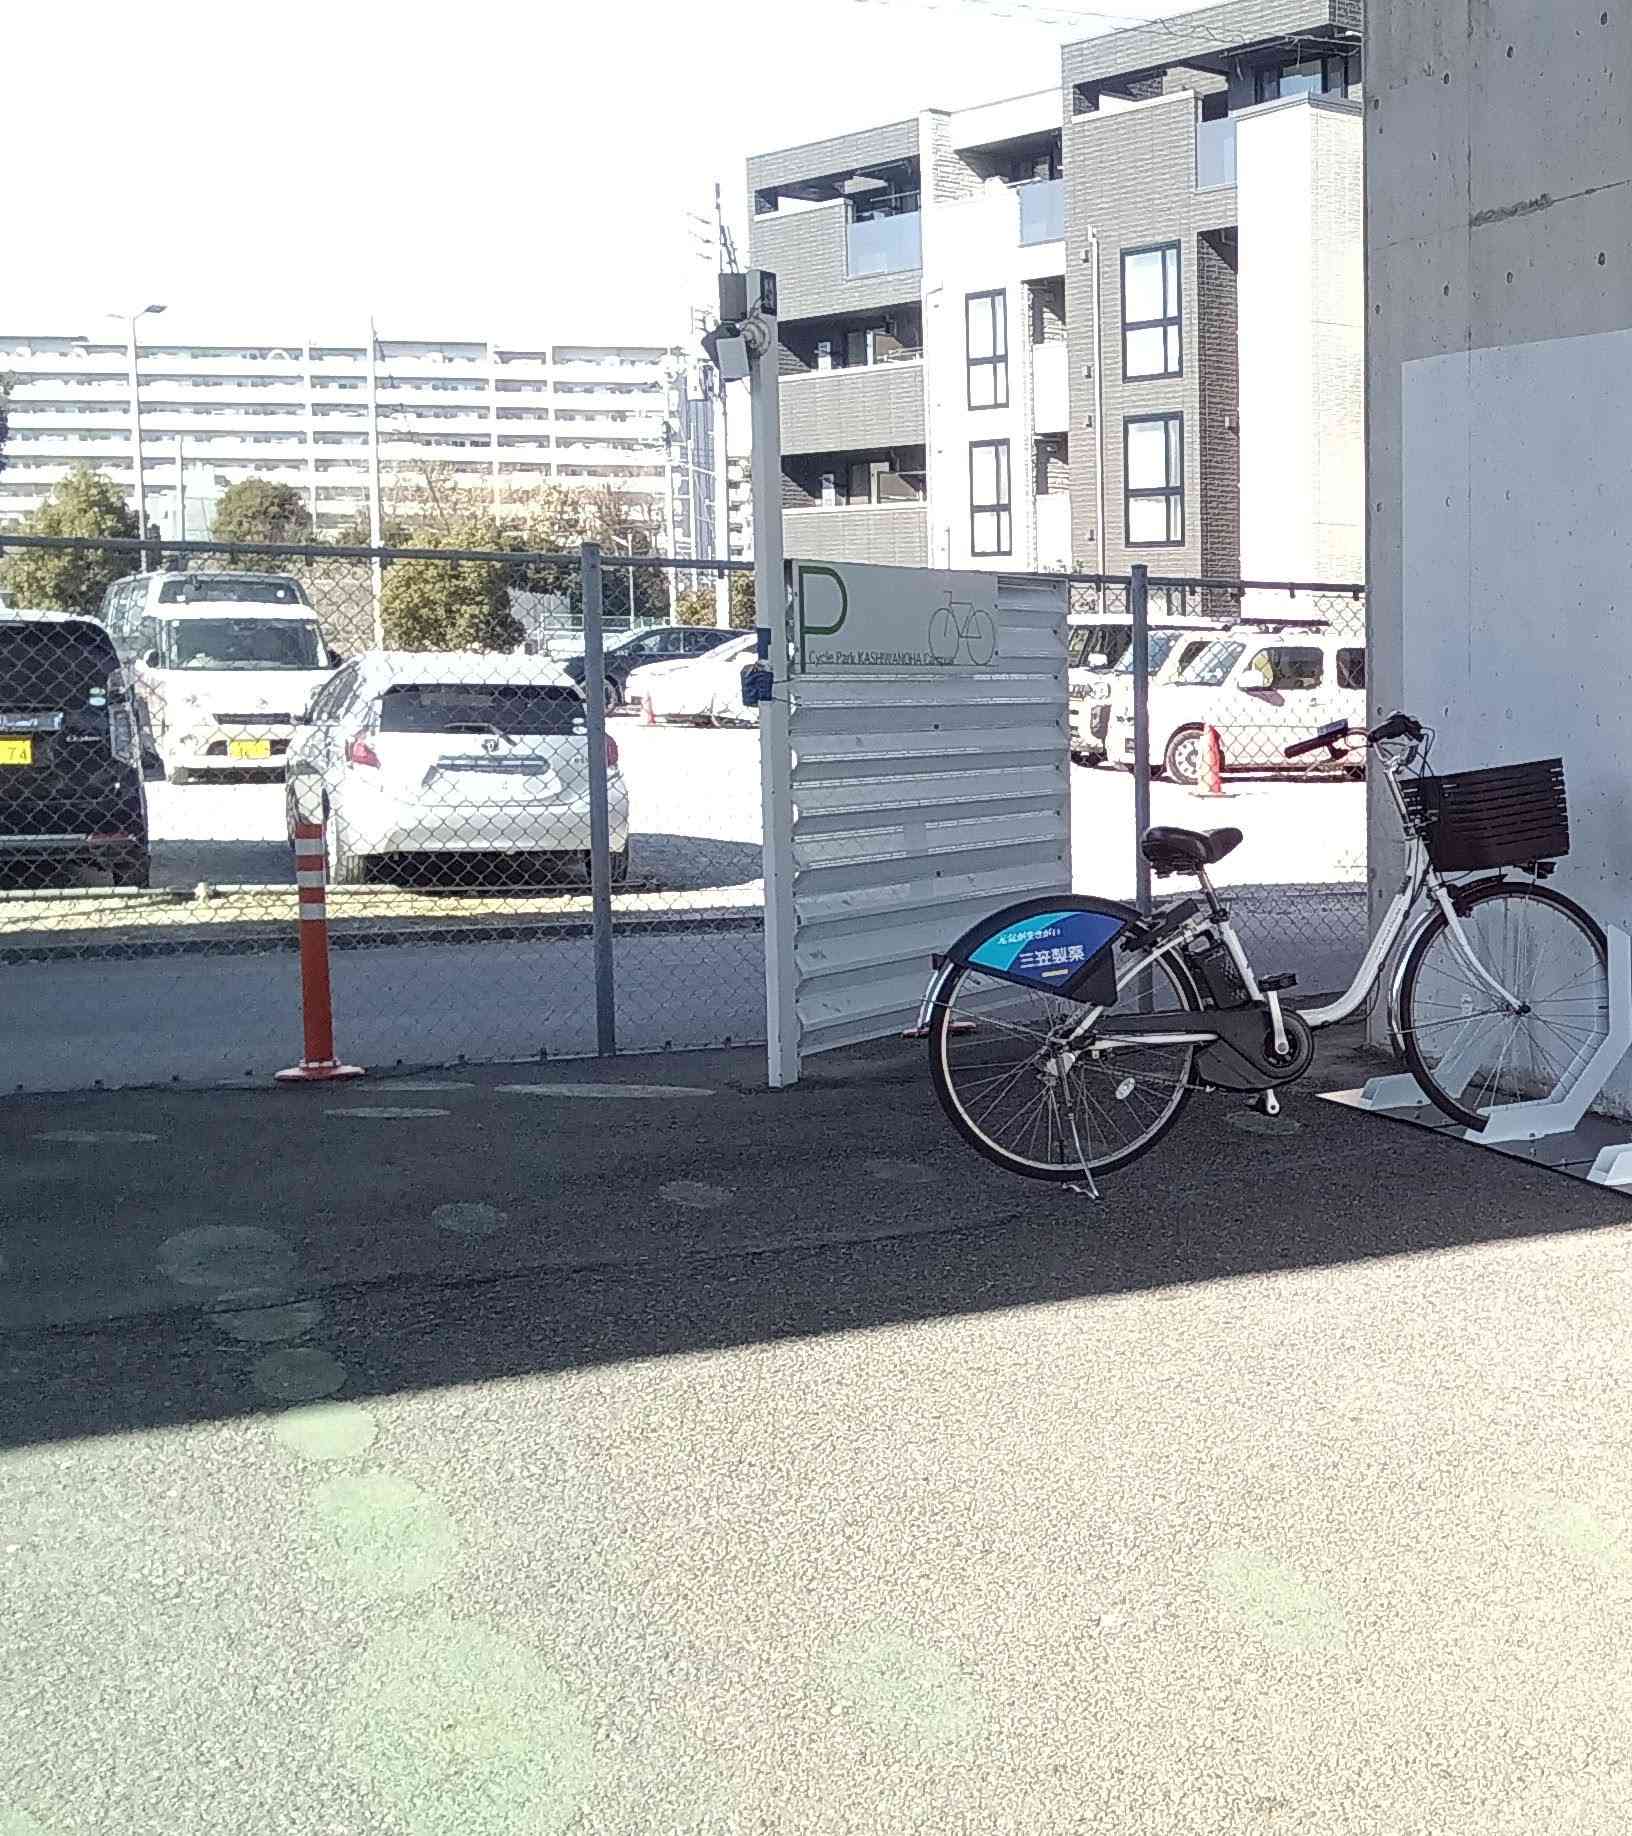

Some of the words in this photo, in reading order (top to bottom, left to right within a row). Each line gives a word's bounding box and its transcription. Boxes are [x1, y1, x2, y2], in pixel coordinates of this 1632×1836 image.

[799, 566, 848, 674] P
[808, 650, 834, 667] Cycle
[836, 651, 856, 665] Park
[1019, 945, 1086, 969] 三笠製薬
